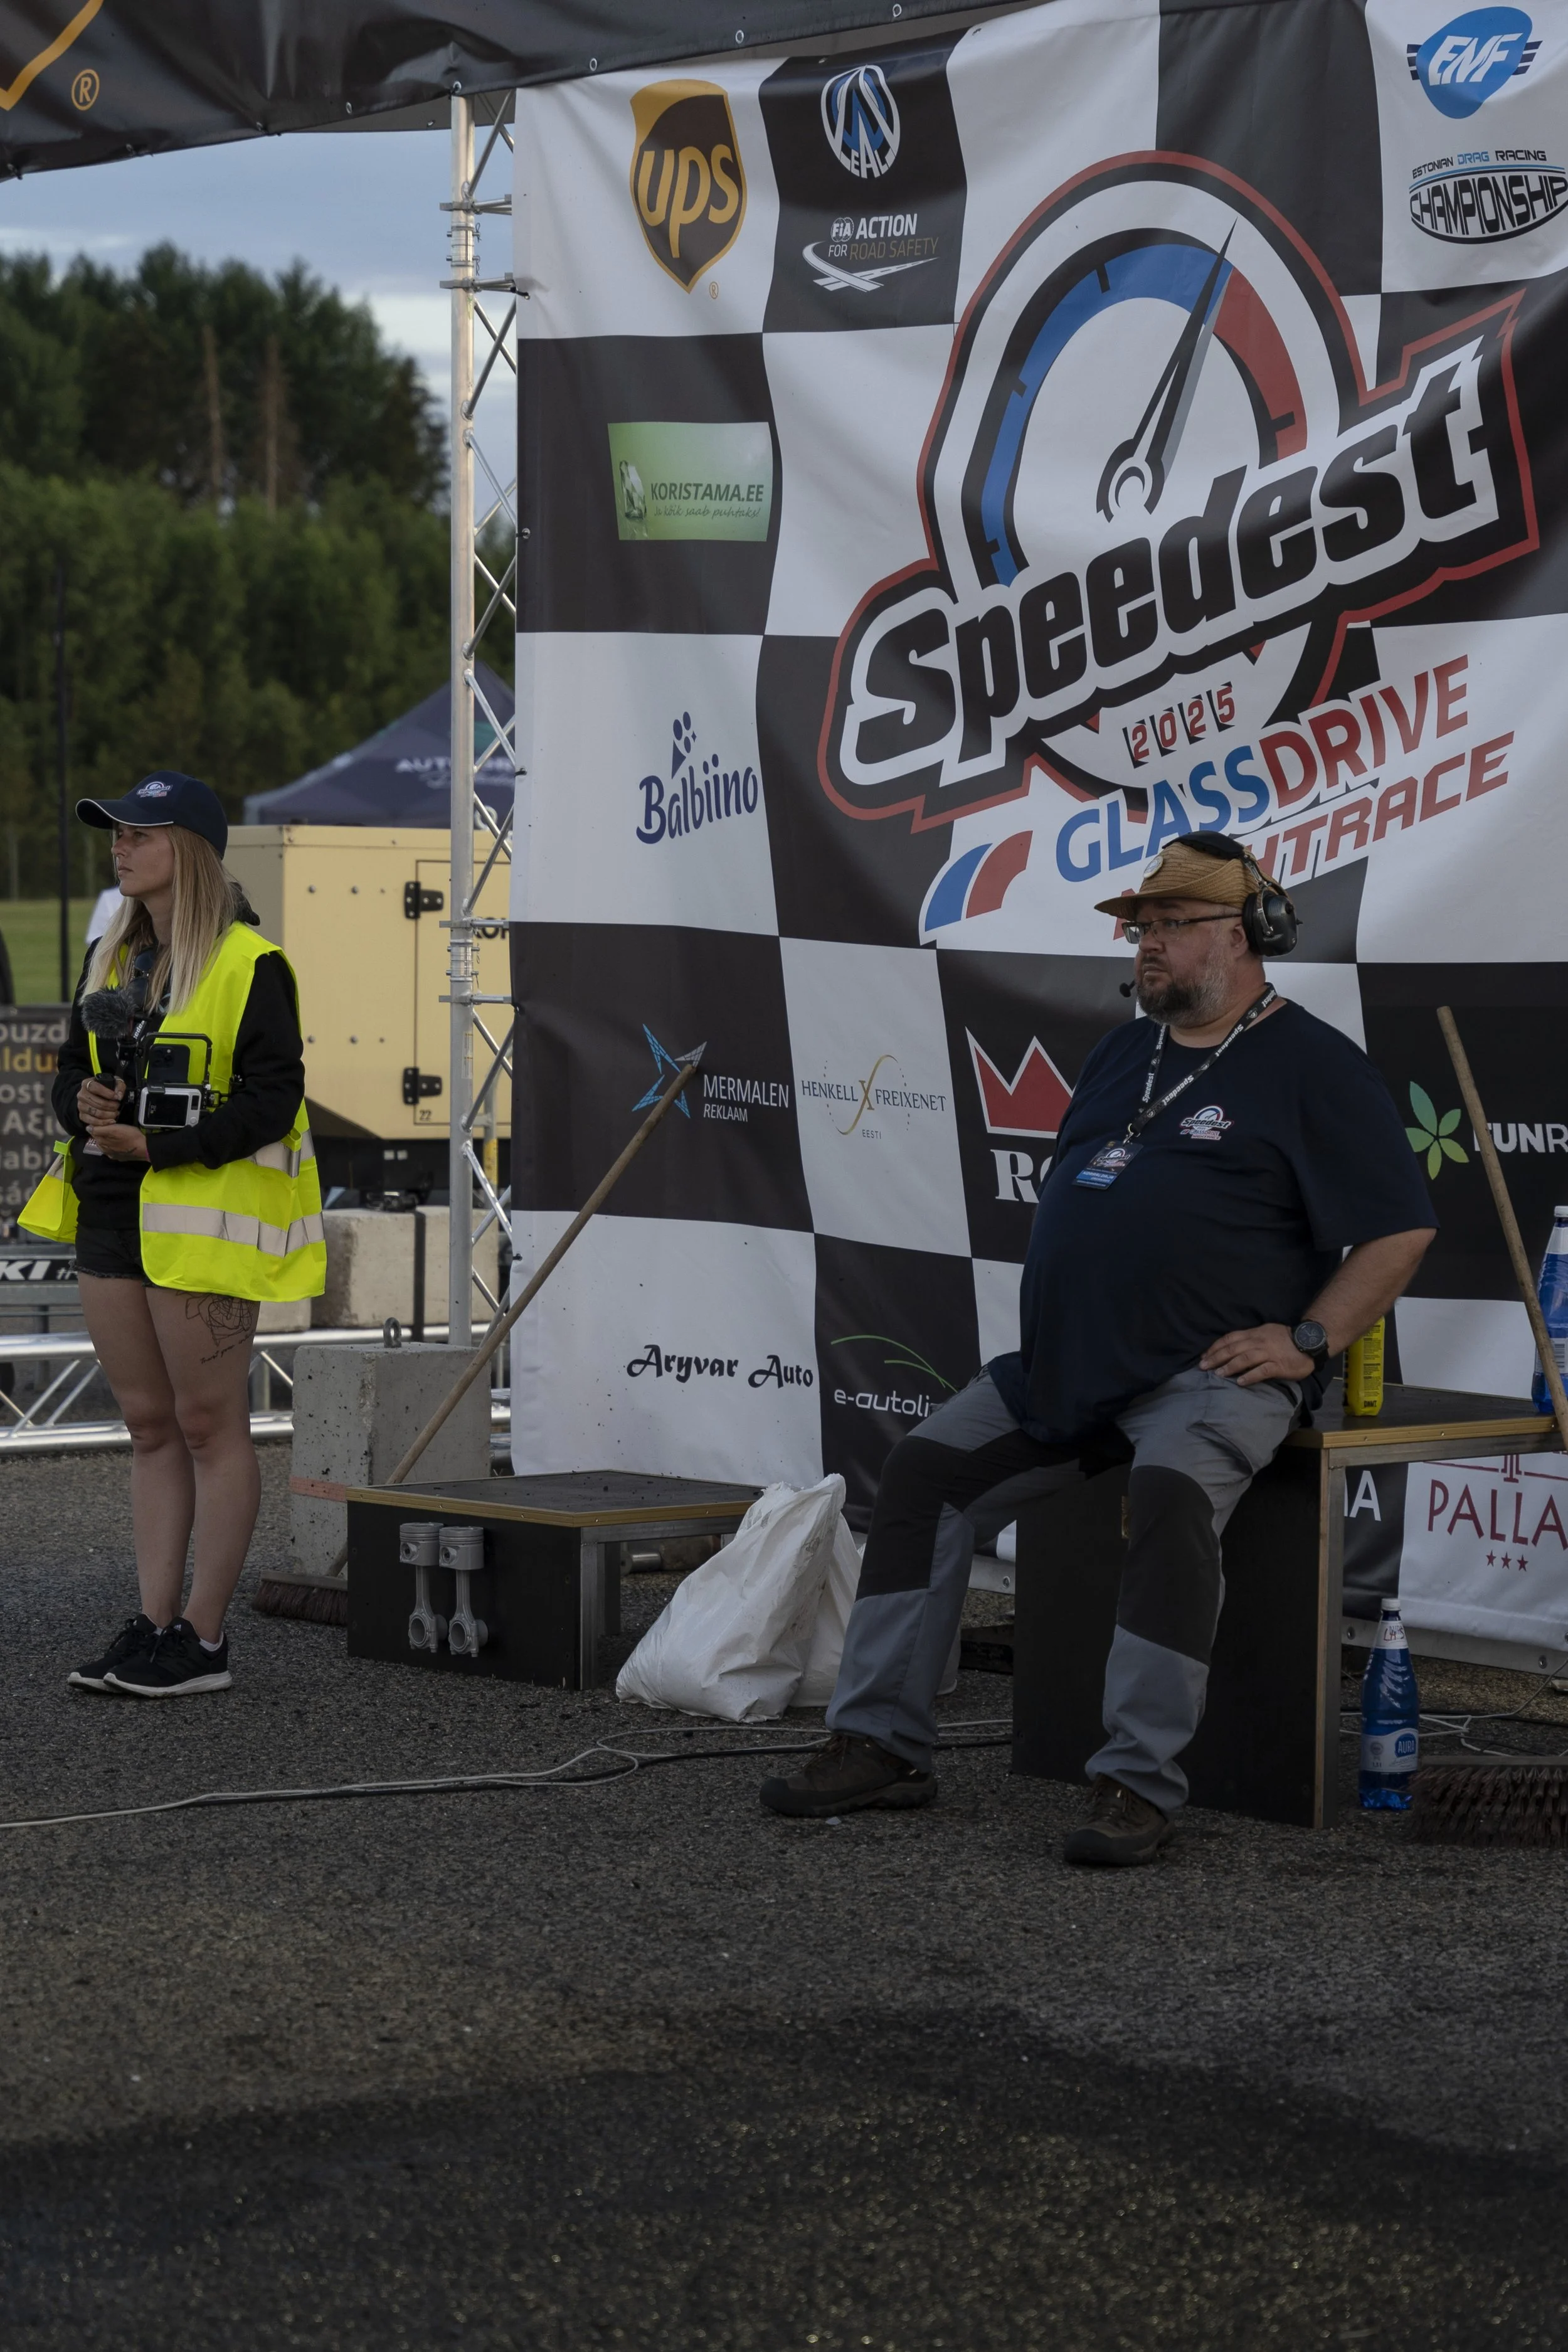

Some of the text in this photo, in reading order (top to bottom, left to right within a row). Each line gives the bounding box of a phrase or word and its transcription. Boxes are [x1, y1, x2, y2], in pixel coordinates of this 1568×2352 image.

[1428, 33, 1523, 88] EMF
[1412, 150, 1547, 179] ESTONIAN DRAG RACING
[1409, 174, 1568, 236] CHAMPIONSHIP
[856, 213, 918, 240] ACTION
[828, 236, 940, 261] FOR ROAD SAFETY
[650, 482, 765, 502] KORISTAMA.EE
[664, 504, 684, 517] kõik
[684, 504, 710, 517] saab
[855, 360, 1476, 765] Speedest
[1122, 682, 1236, 768] 2025
[1056, 654, 1469, 882] GLASSDRIVE
[636, 754, 758, 844] Balbiino
[1214, 1023, 1245, 1057] Speedest
[703, 1074, 790, 1109] MERMALEN
[801, 1080, 859, 1102] HENKELL
[875, 1089, 947, 1112] FREIXENET
[1142, 1072, 1155, 1103] Speedest
[1161, 1074, 1195, 1106] Speedest
[703, 1103, 748, 1123] REKLAAM
[1182, 1118, 1230, 1128] Speedest
[862, 1129, 882, 1140] EESTI
[627, 1344, 814, 1389] Aryvar Auto
[834, 1389, 930, 1418] e-autoli
[1428, 1479, 1568, 1551] PALLA
[1397, 1740, 1416, 1754] AURA
